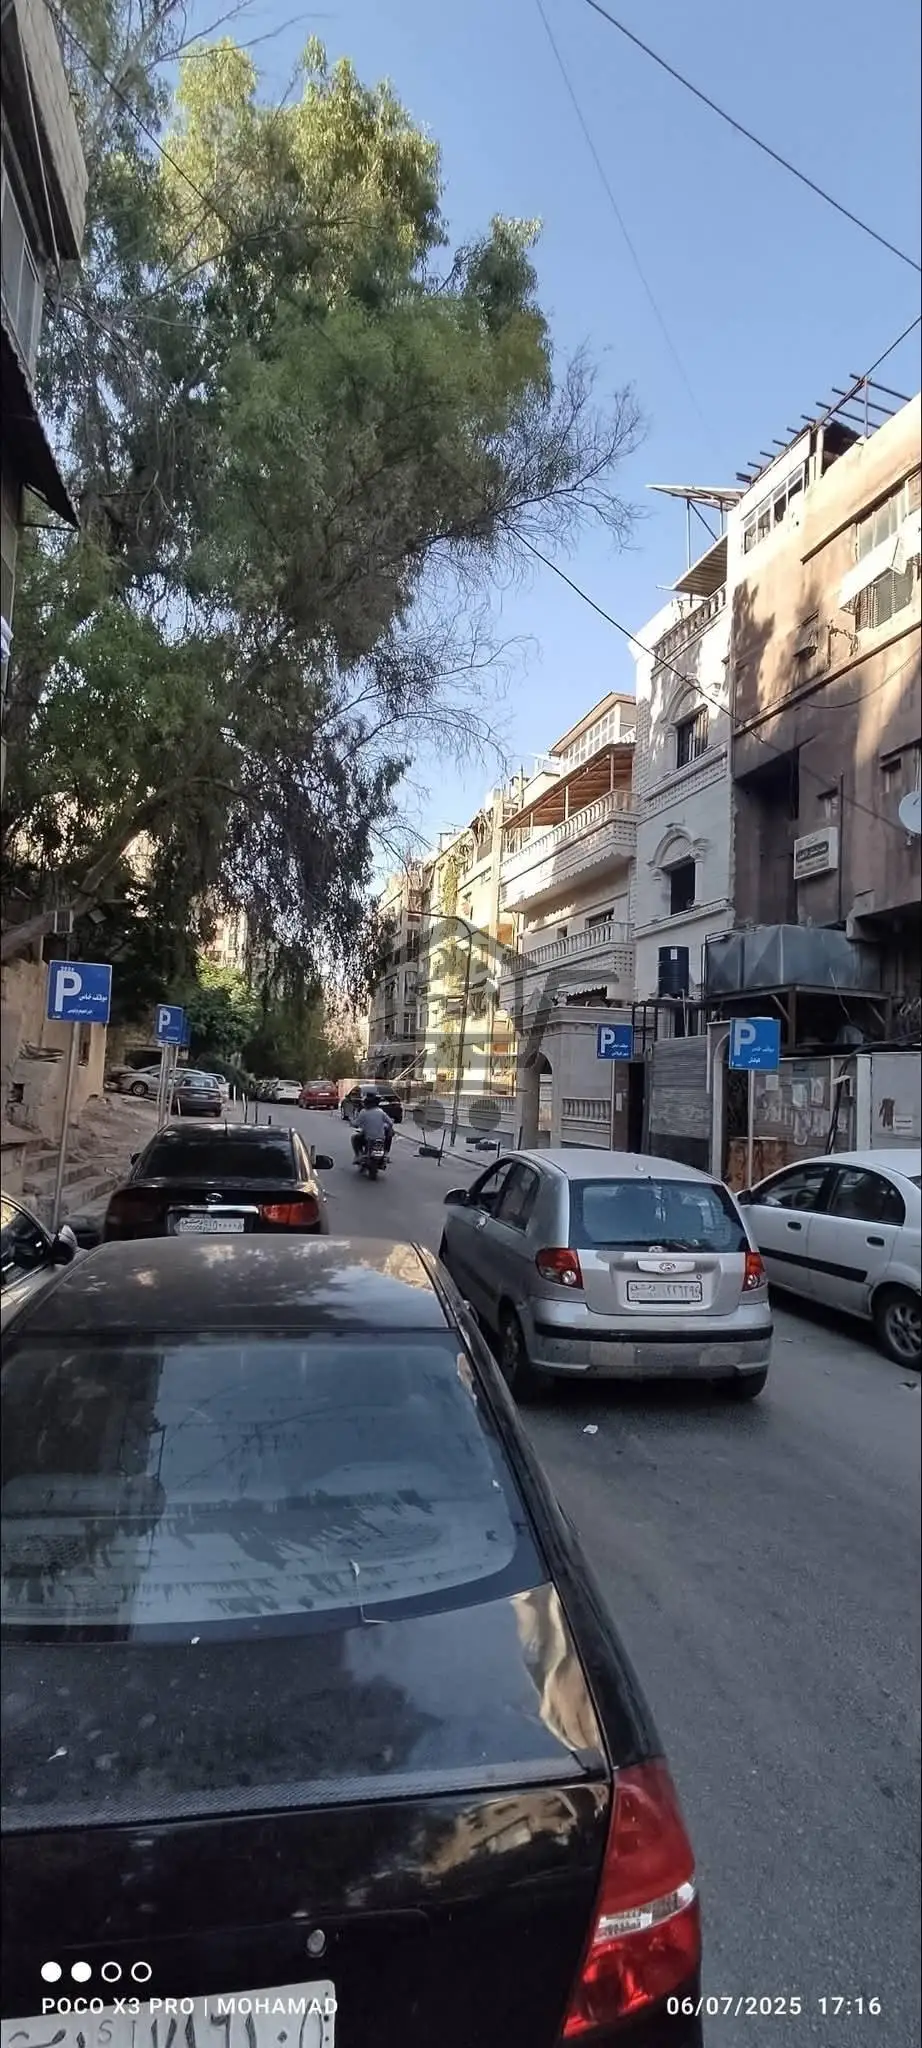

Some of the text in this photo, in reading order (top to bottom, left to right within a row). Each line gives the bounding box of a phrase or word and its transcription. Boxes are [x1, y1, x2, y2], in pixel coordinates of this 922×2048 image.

[55, 970, 82, 1012] P
[158, 1007, 171, 1033] P
[601, 1027, 615, 1053] P
[734, 1020, 756, 1056] P
